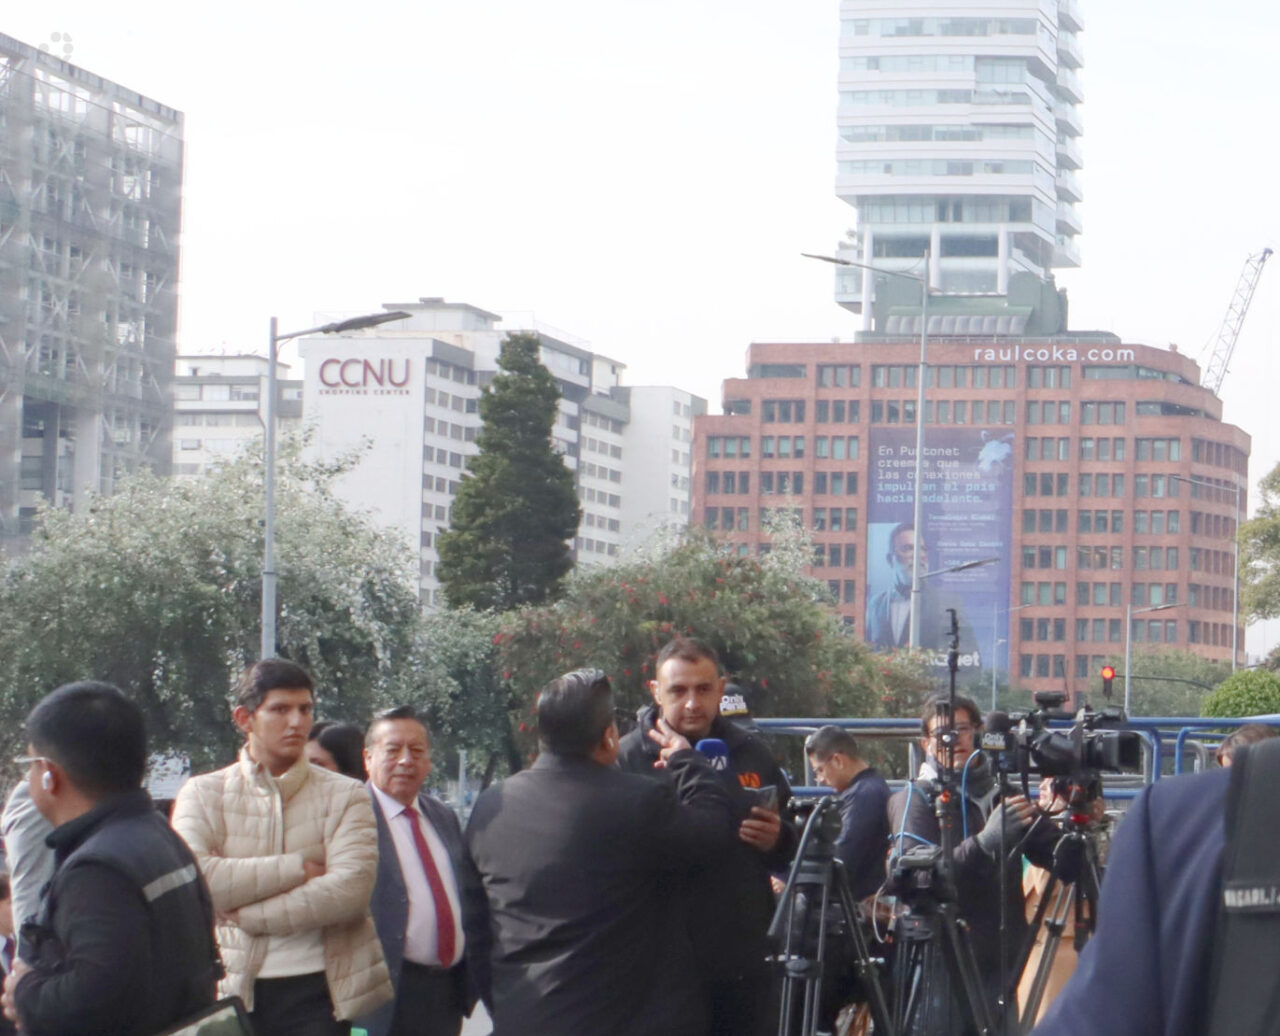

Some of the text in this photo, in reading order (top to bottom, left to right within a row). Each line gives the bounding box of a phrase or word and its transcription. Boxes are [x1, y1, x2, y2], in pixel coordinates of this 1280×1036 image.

[974, 345, 1135, 362] raulcoka.com
[319, 358, 410, 387] CCNU
[878, 445, 960, 456] En Putonet
[878, 459, 960, 470] creems que
[877, 469, 900, 480] las
[877, 481, 936, 492] impulan
[876, 493, 914, 503] hacia
